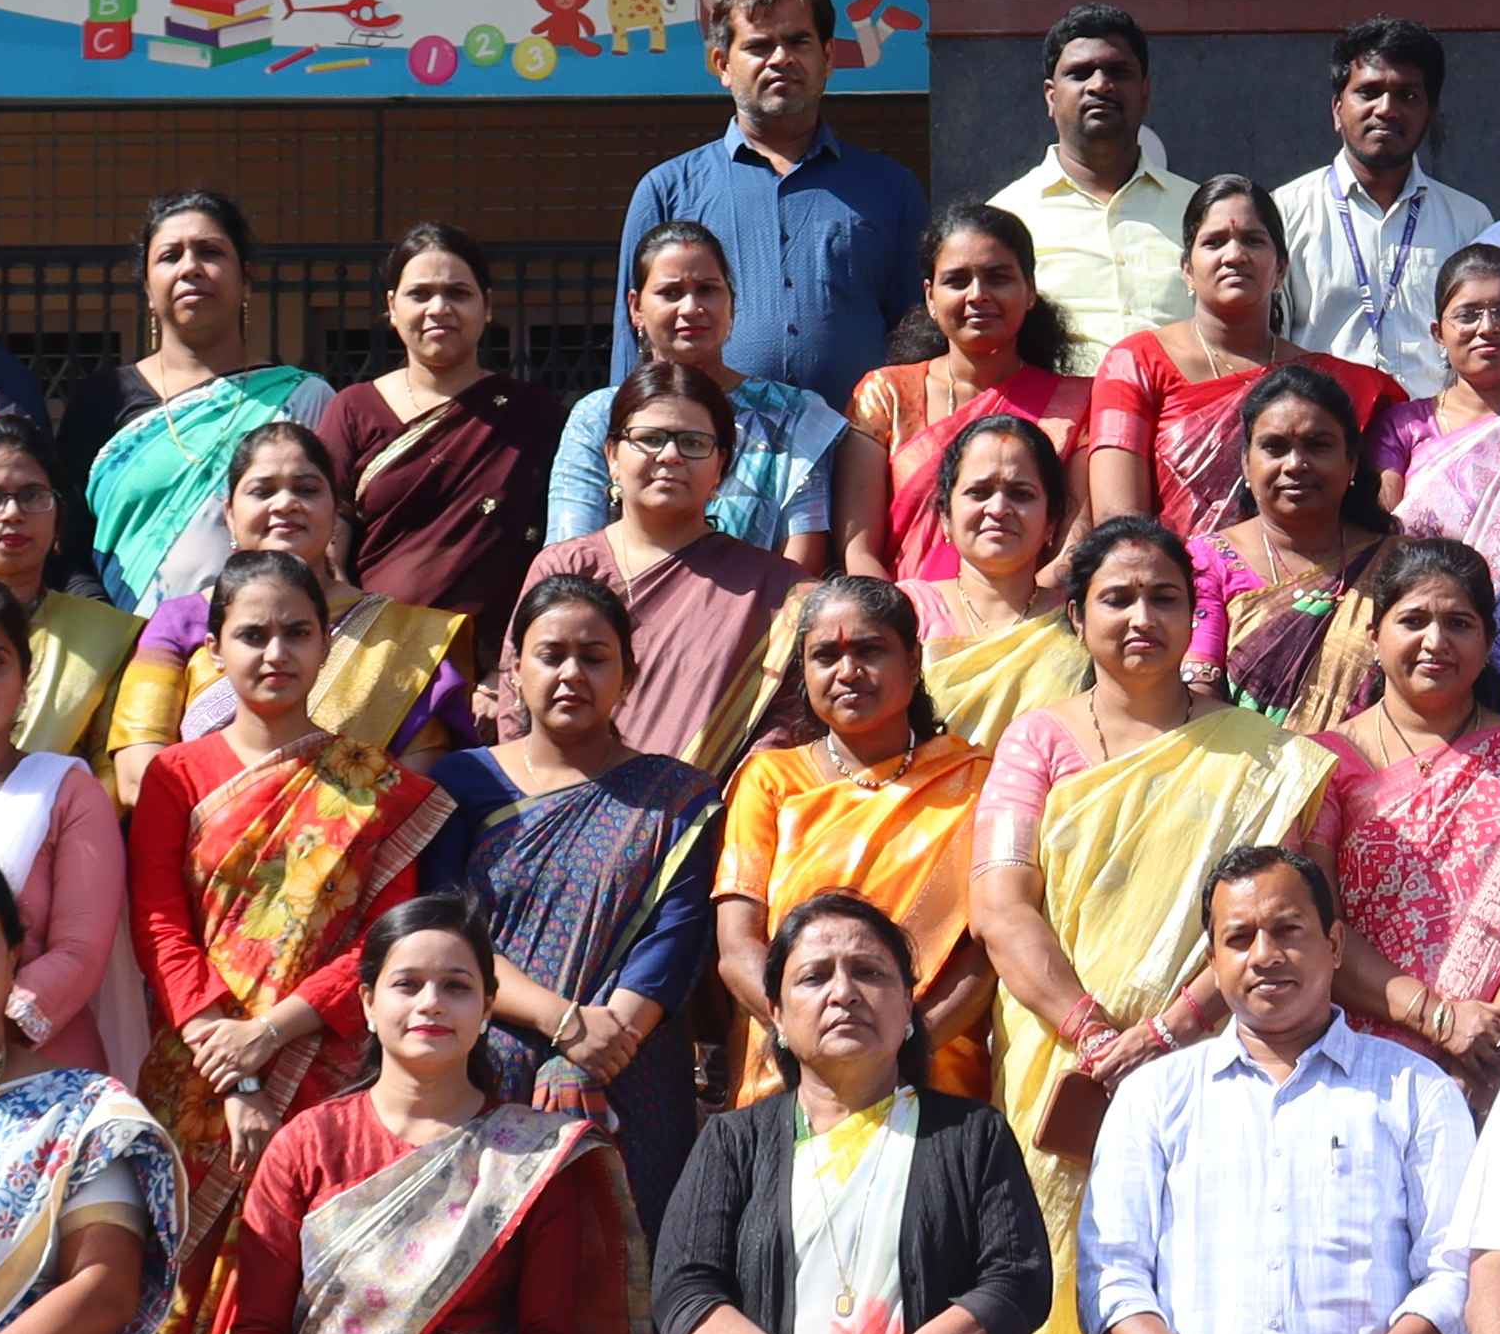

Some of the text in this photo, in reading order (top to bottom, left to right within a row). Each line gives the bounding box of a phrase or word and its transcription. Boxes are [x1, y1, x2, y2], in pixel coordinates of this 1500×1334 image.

[93, 30, 114, 52] C
[476, 34, 495, 58] 2
[525, 46, 544, 71] 3
